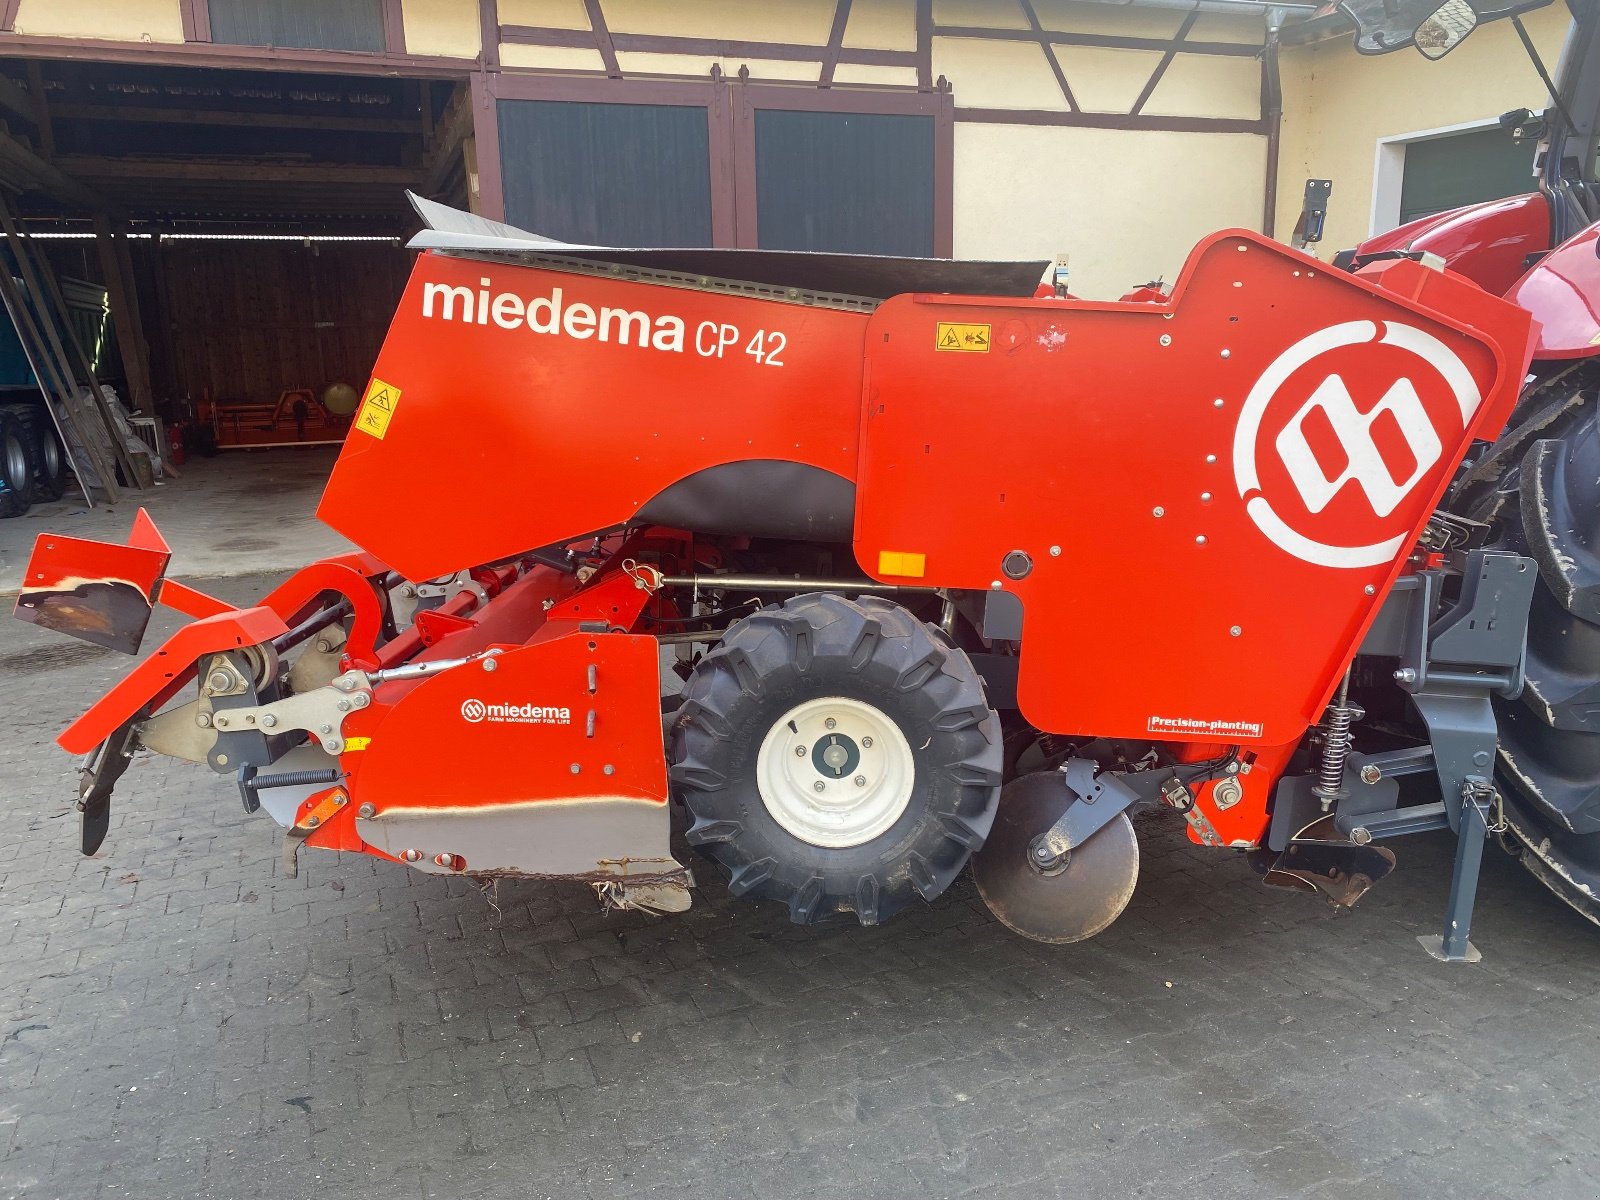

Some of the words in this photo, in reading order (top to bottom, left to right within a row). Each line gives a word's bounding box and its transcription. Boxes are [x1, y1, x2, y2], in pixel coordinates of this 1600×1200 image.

[422, 277, 685, 352] miedema
[695, 320, 740, 358] CP
[745, 329, 787, 367] 42
[487, 702, 570, 718] miedema
[1151, 716, 1260, 732] Precision-planting
